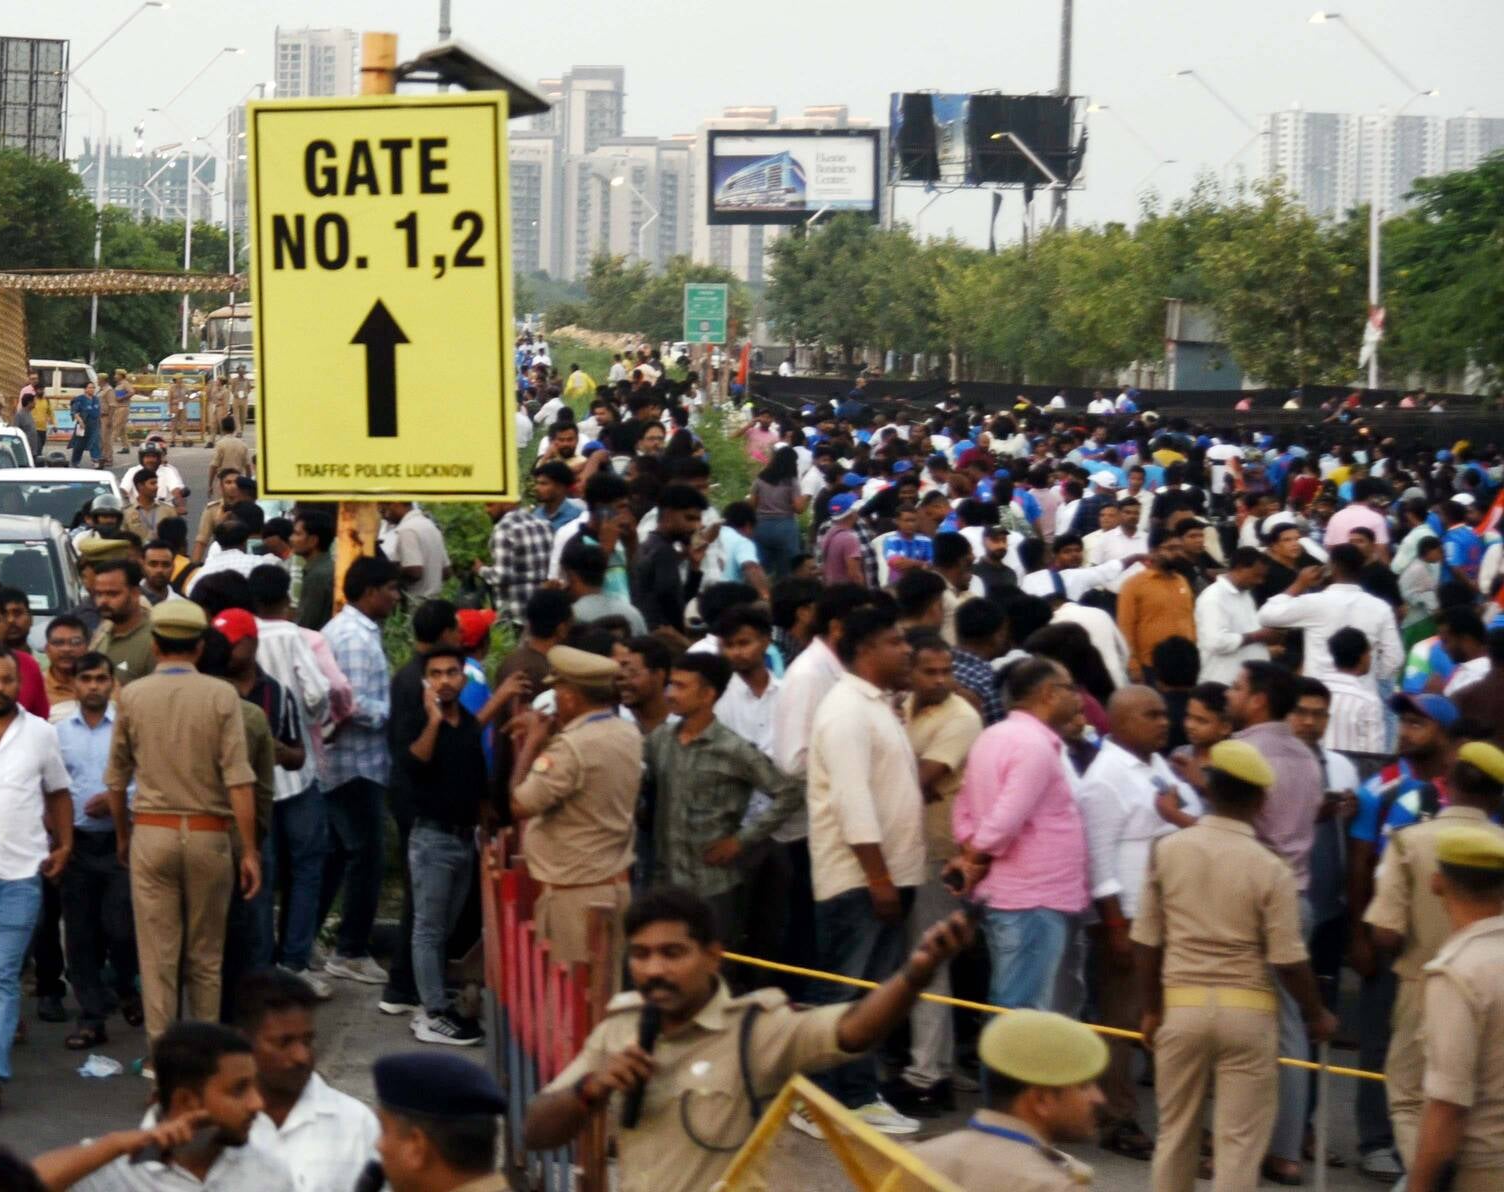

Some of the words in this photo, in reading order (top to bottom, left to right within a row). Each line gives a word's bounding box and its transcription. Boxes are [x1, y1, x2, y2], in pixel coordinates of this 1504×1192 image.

[304, 137, 450, 198] GATE
[272, 212, 368, 271] NO.
[394, 210, 486, 280] 1,2
[296, 464, 351, 478] TRAFFIC
[355, 464, 401, 478] POLICE
[406, 464, 474, 478] LUCKNOW
